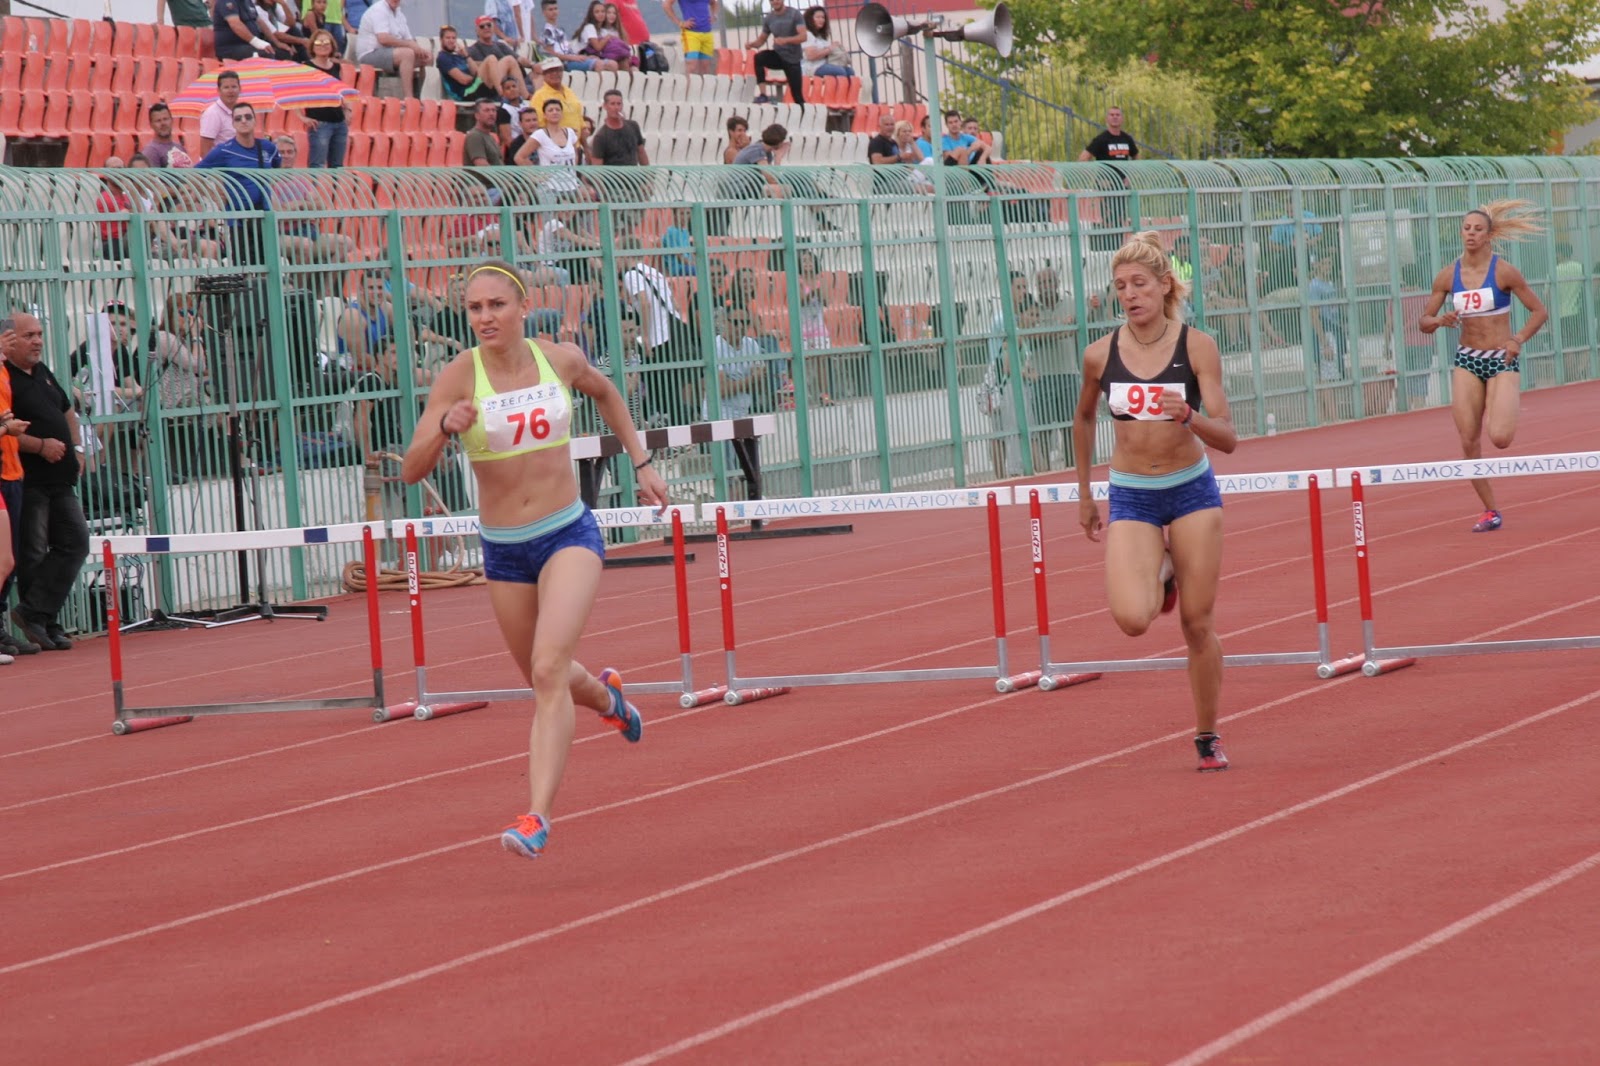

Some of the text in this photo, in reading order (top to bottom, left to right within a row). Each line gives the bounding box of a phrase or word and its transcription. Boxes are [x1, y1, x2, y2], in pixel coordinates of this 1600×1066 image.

[1462, 292, 1482, 310] 79
[1127, 385, 1165, 415] 93
[506, 407, 551, 446] 76
[1392, 455, 1600, 481] ΔΗΜΟΣ ΣΧΗΜΑΤΑΡΙΟ
[754, 494, 958, 516] ΔΗΜΟΣ ΣΧΗΜΑΤΑΡΙΟΥ
